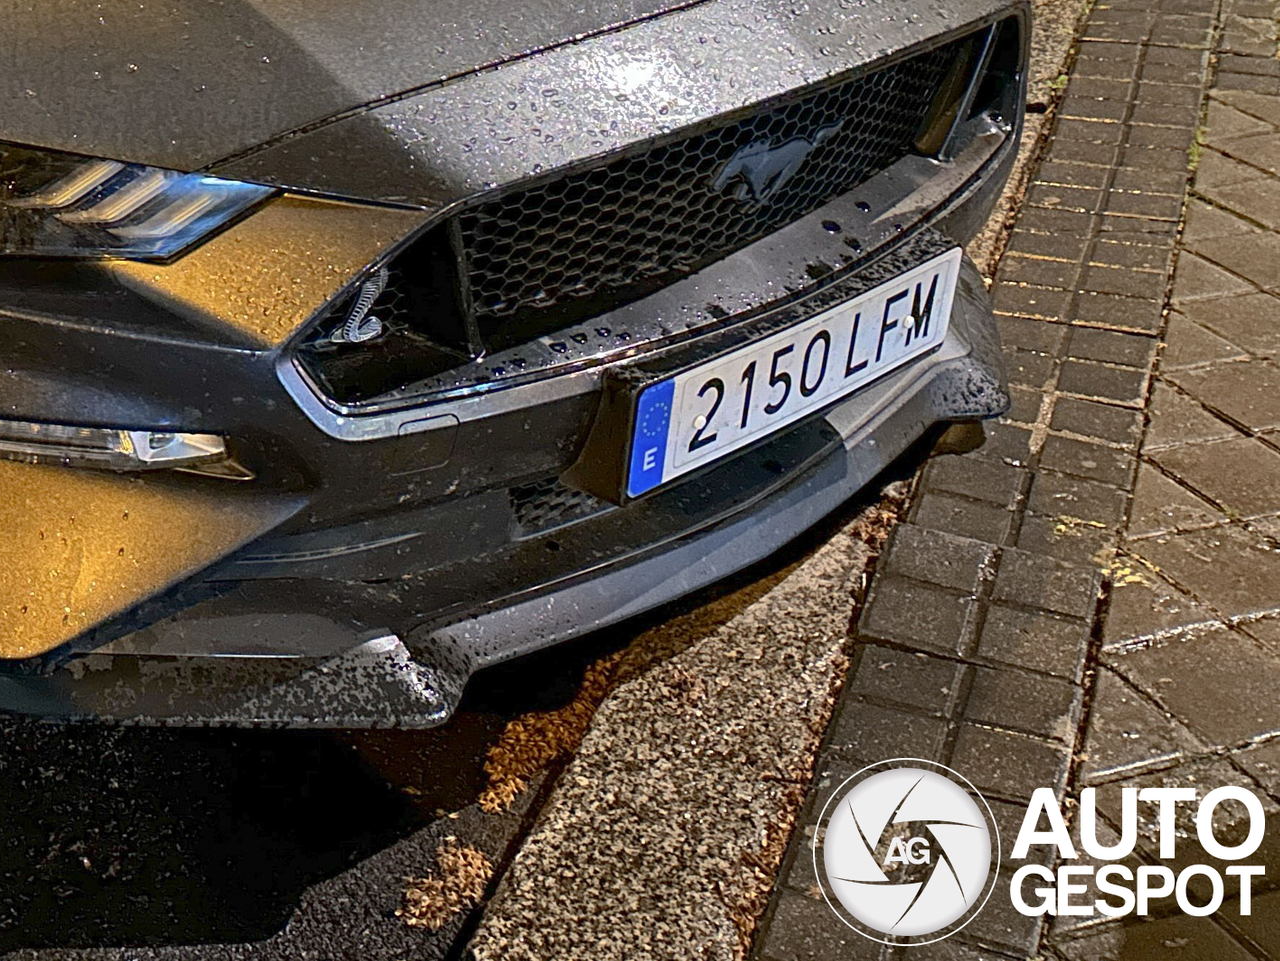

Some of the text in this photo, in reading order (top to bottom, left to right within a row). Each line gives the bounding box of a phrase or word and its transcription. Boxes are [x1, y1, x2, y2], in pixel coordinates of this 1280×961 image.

[687, 272, 940, 454] 2150 LFM
[642, 446, 659, 472] E
